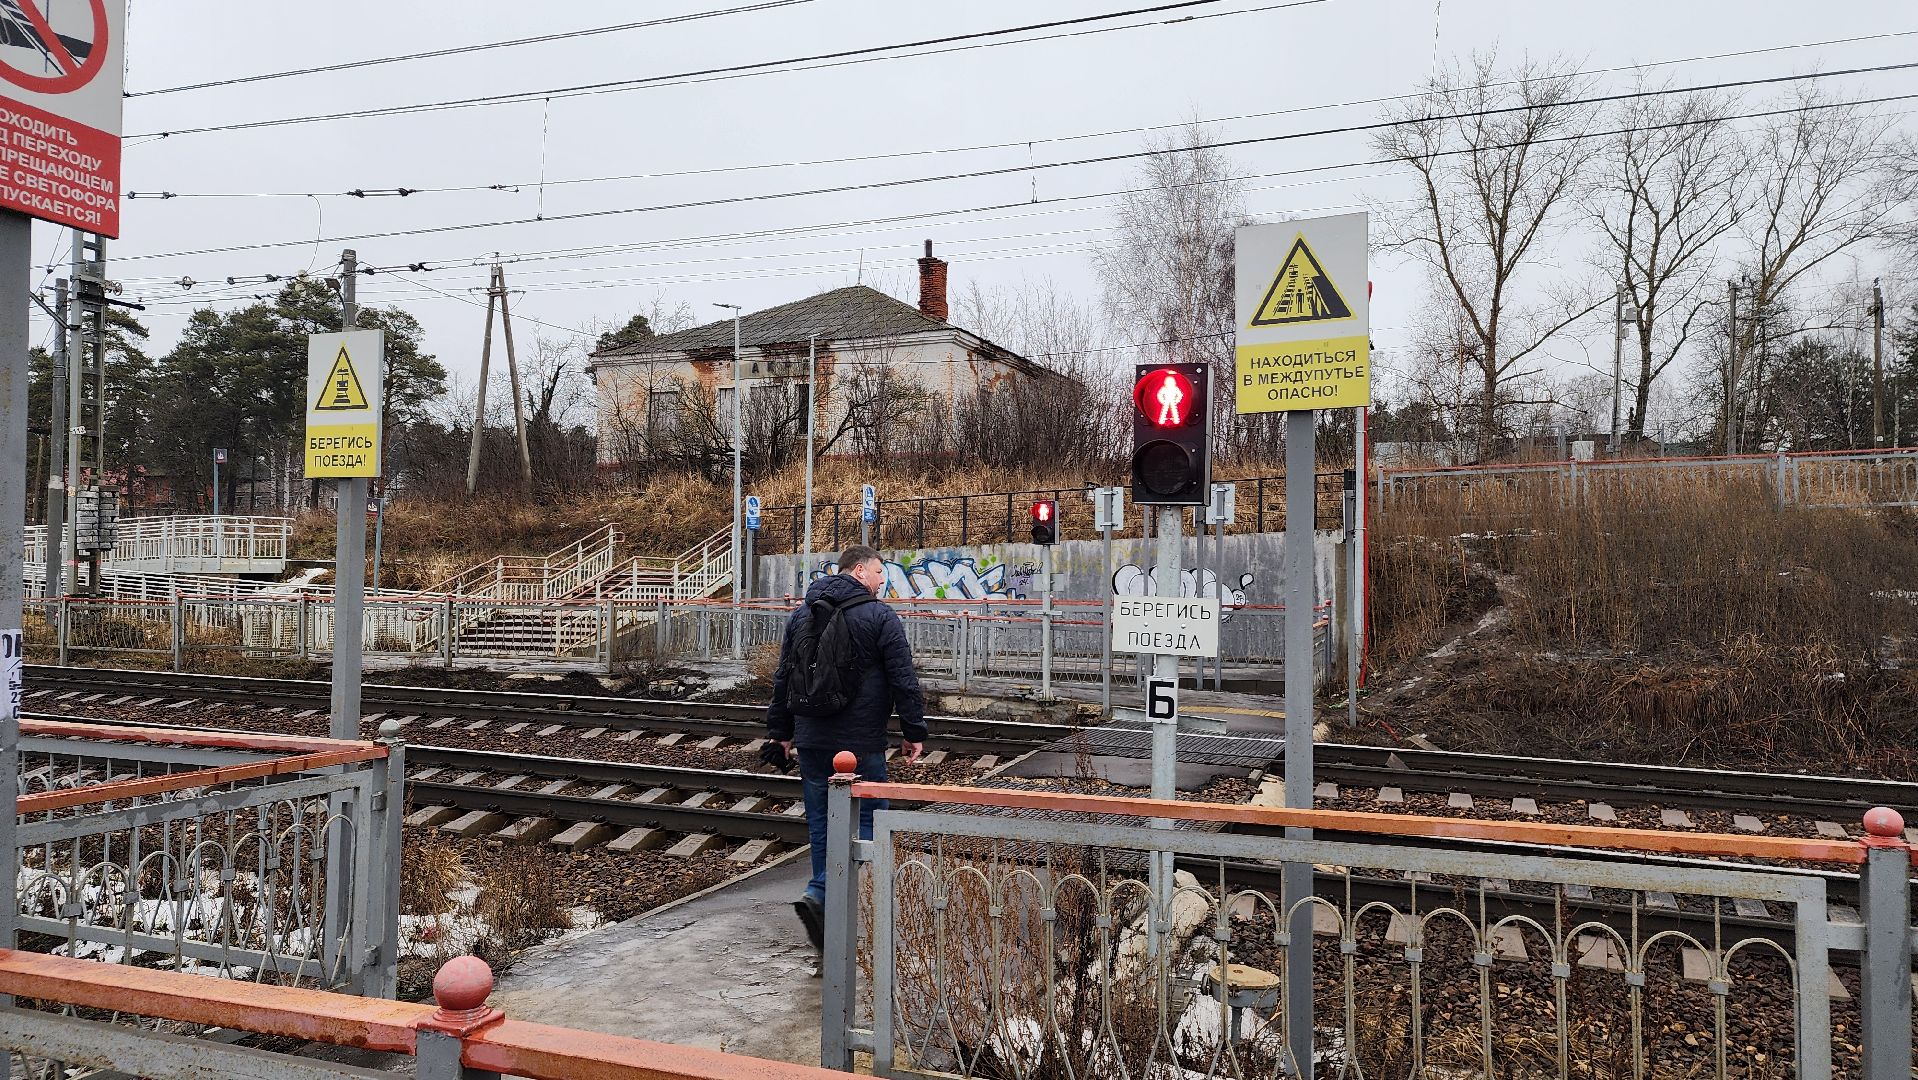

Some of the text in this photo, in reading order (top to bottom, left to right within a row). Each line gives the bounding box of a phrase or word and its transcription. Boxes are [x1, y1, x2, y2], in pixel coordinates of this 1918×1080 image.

[12, 132, 101, 171] ПЕРЕХОДУ
[13, 170, 116, 212] СВЕТОФОРА
[1250, 350, 1356, 369] НАХОДИТЬСЯ
[1243, 366, 1364, 386] В МЕЖДУПУТЬЕ
[1267, 385, 1338, 400] ОПАСНО!
[310, 436, 373, 449] БЕРЕГИСЬ
[314, 454, 366, 469] ПОЕЗДА!
[1120, 602, 1211, 620] БЕРЕГИСЬ
[1128, 631, 1201, 650] ПОЕЗДА
[1148, 681, 1175, 719] Б
